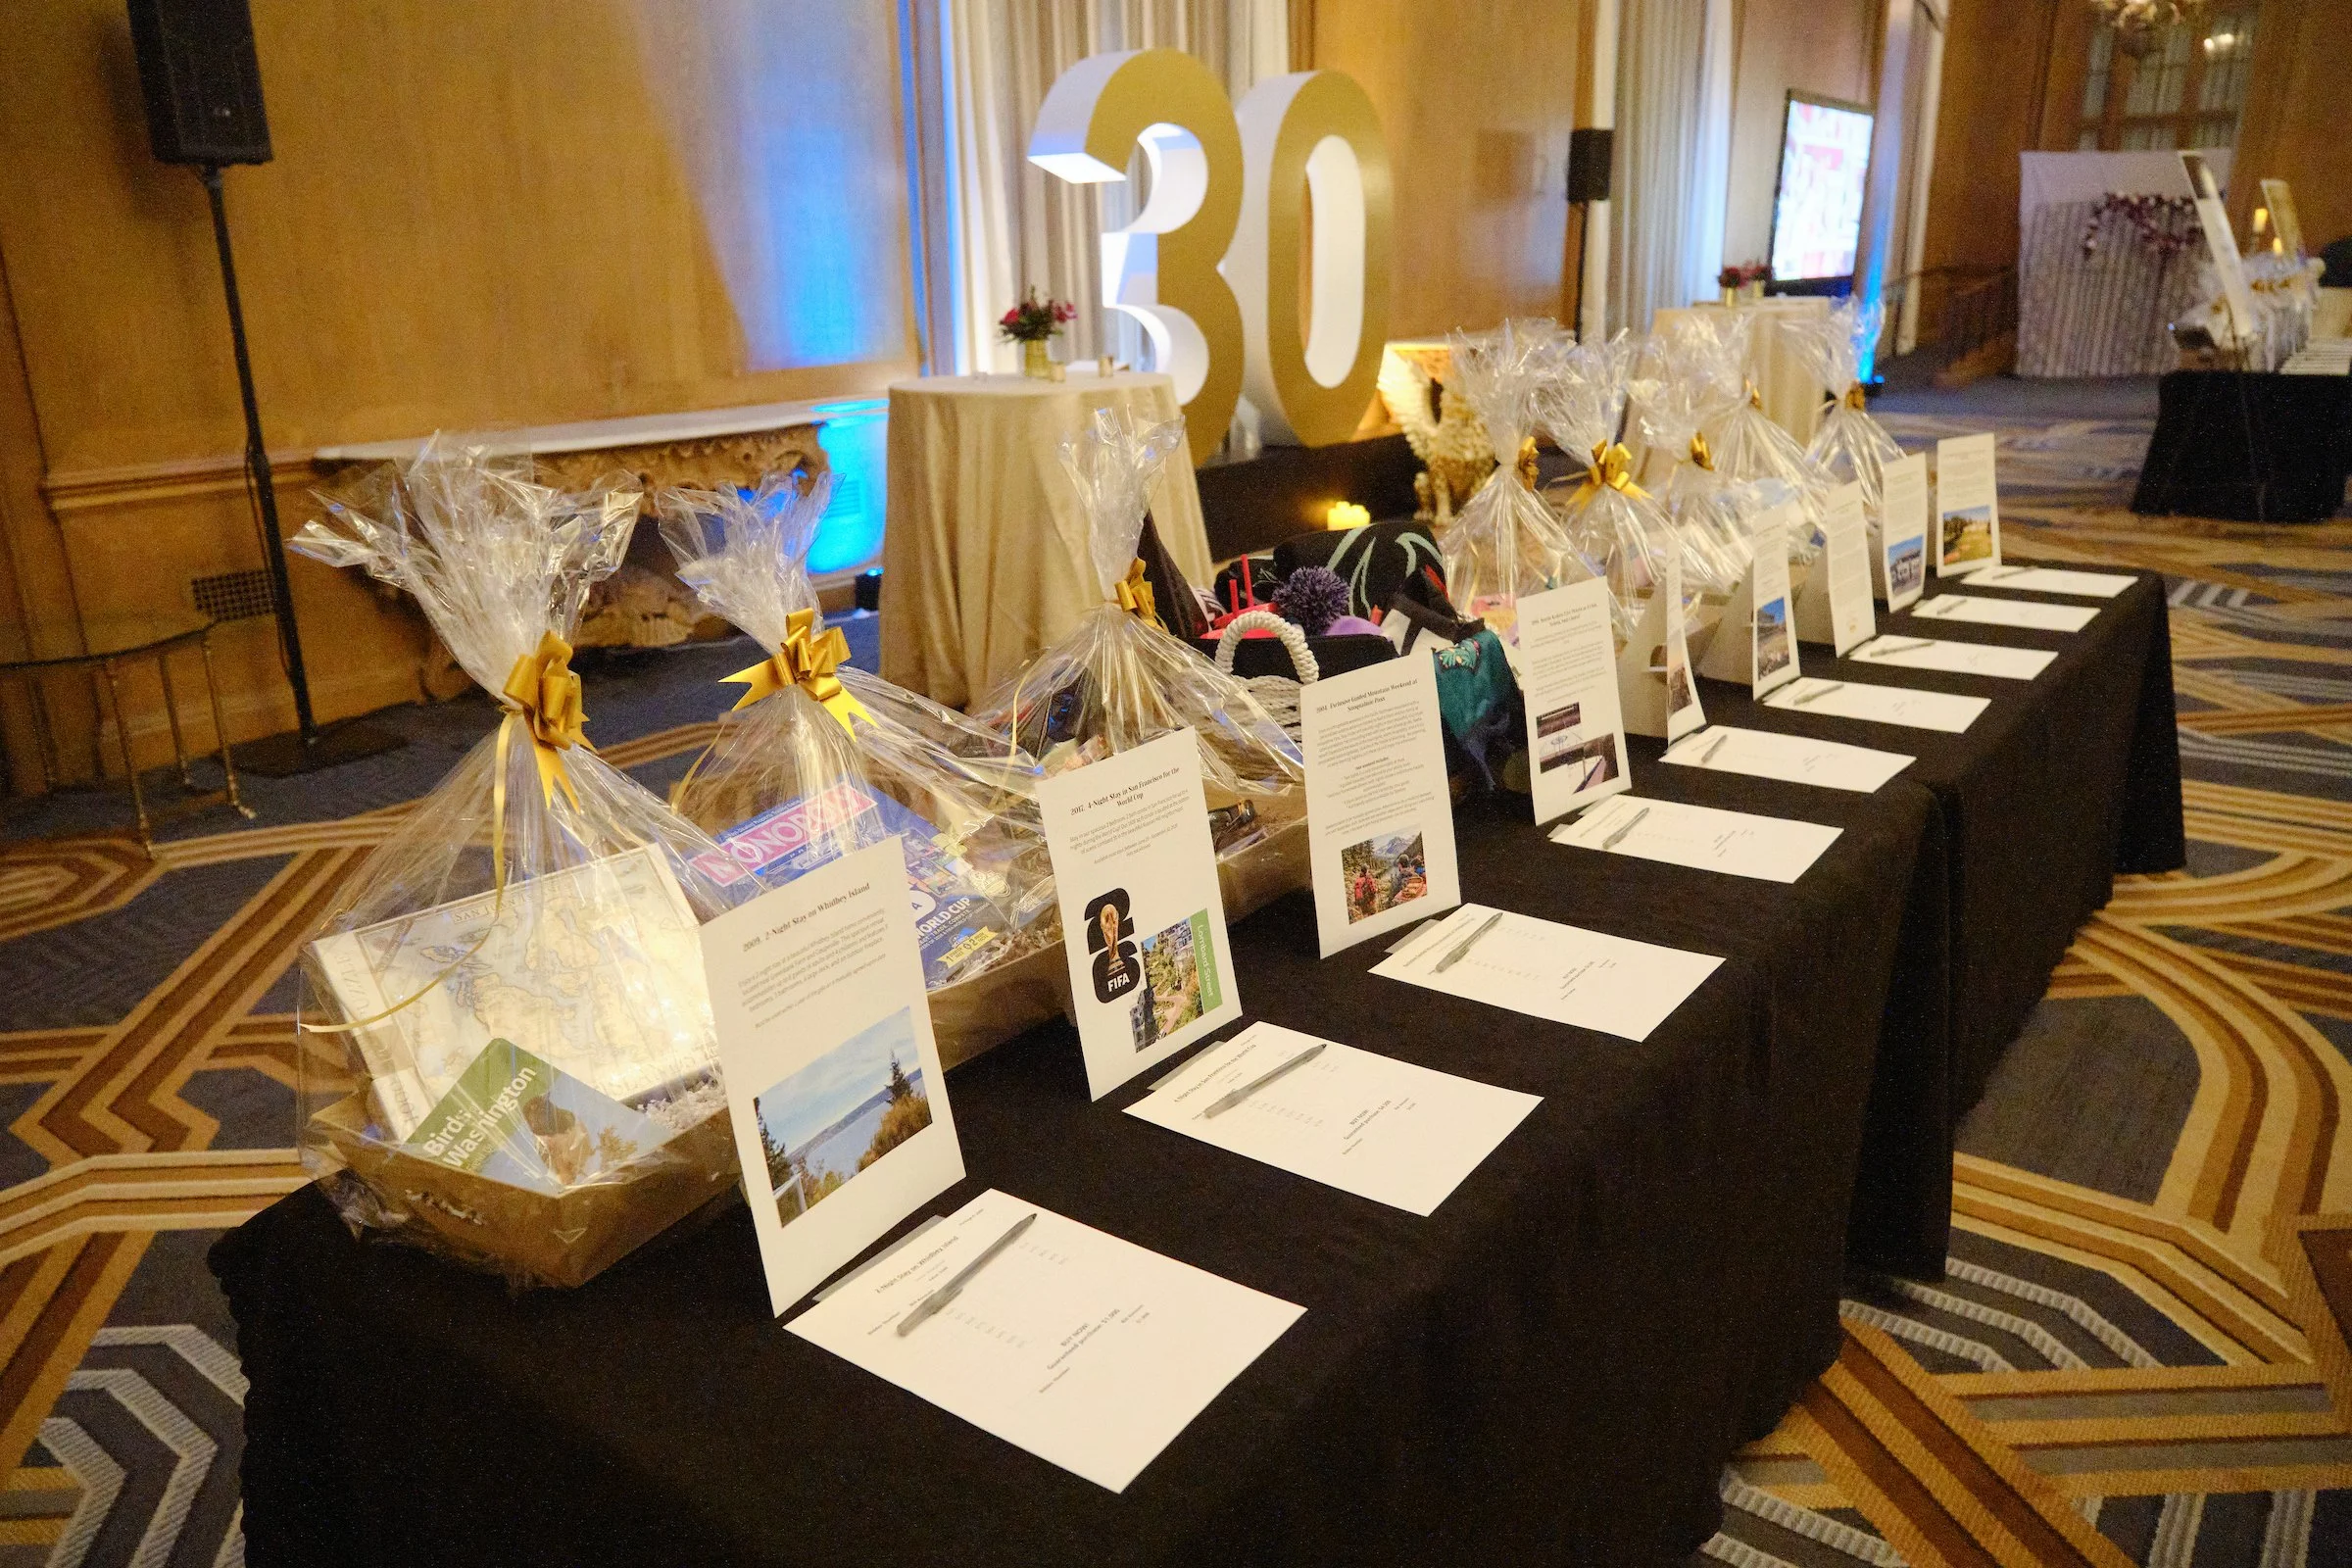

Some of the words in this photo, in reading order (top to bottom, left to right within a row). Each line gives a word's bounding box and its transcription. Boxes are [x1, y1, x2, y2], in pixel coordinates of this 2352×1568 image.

[1029, 47, 1393, 468] 30
[1139, 774, 1162, 788] Francisco
[1116, 796, 1133, 807] World
[705, 788, 868, 879] MONOPO
[455, 908, 479, 922] SAN
[792, 915, 807, 924] Stay
[817, 896, 847, 911] Whidbey
[849, 882, 870, 898] Island
[948, 897, 970, 915] CUP
[1198, 926, 1209, 971] Lombard
[1107, 972, 1130, 992] FIFA
[1203, 967, 1214, 997] Street
[443, 1066, 536, 1166] Washington
